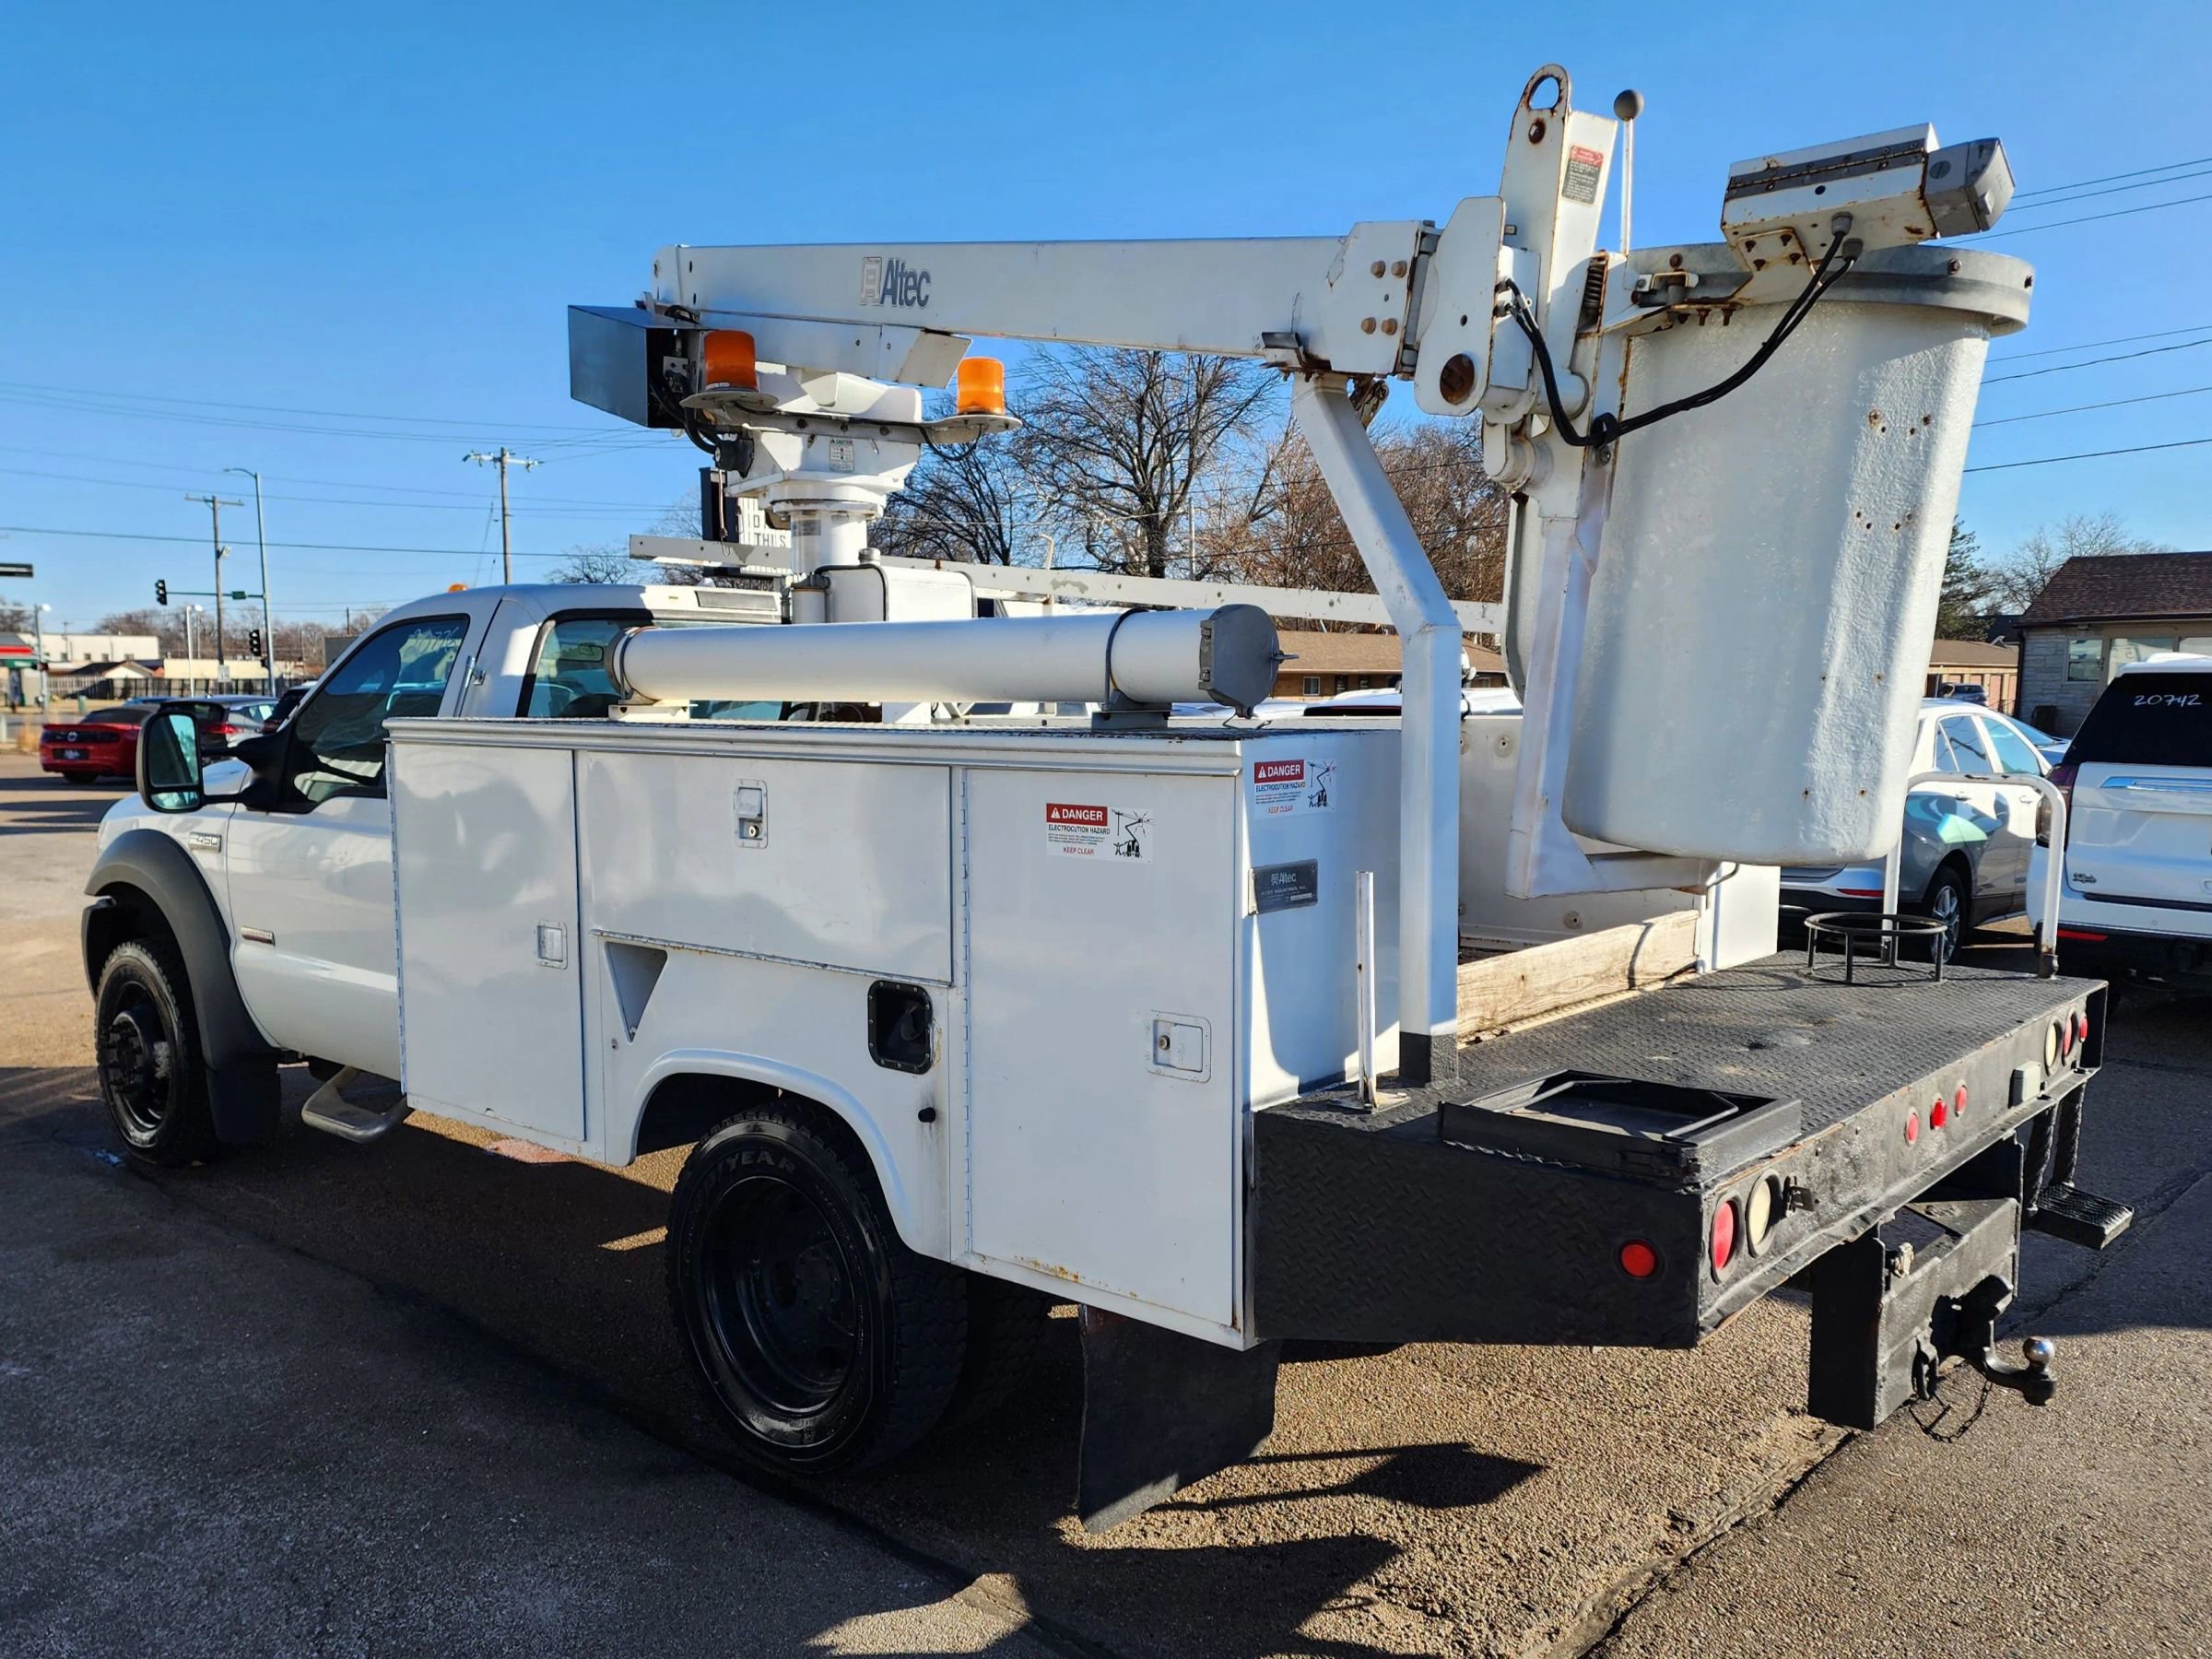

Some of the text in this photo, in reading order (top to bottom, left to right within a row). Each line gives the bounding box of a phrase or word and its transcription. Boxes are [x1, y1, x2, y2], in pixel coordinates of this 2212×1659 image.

[880, 259, 931, 307] Altec
[754, 533, 786, 547] THIS
[2134, 694, 2202, 707] 20742
[1267, 764, 1301, 777] DANGER
[1255, 781, 1306, 793] ELECTROCUTION HAZARD
[1062, 808, 1103, 821] DANGER
[1048, 824, 1111, 835] ELECTROCUTION HAZARD
[1063, 846, 1094, 855] KEEP CLEAR
[1279, 872, 1297, 885] Altec
